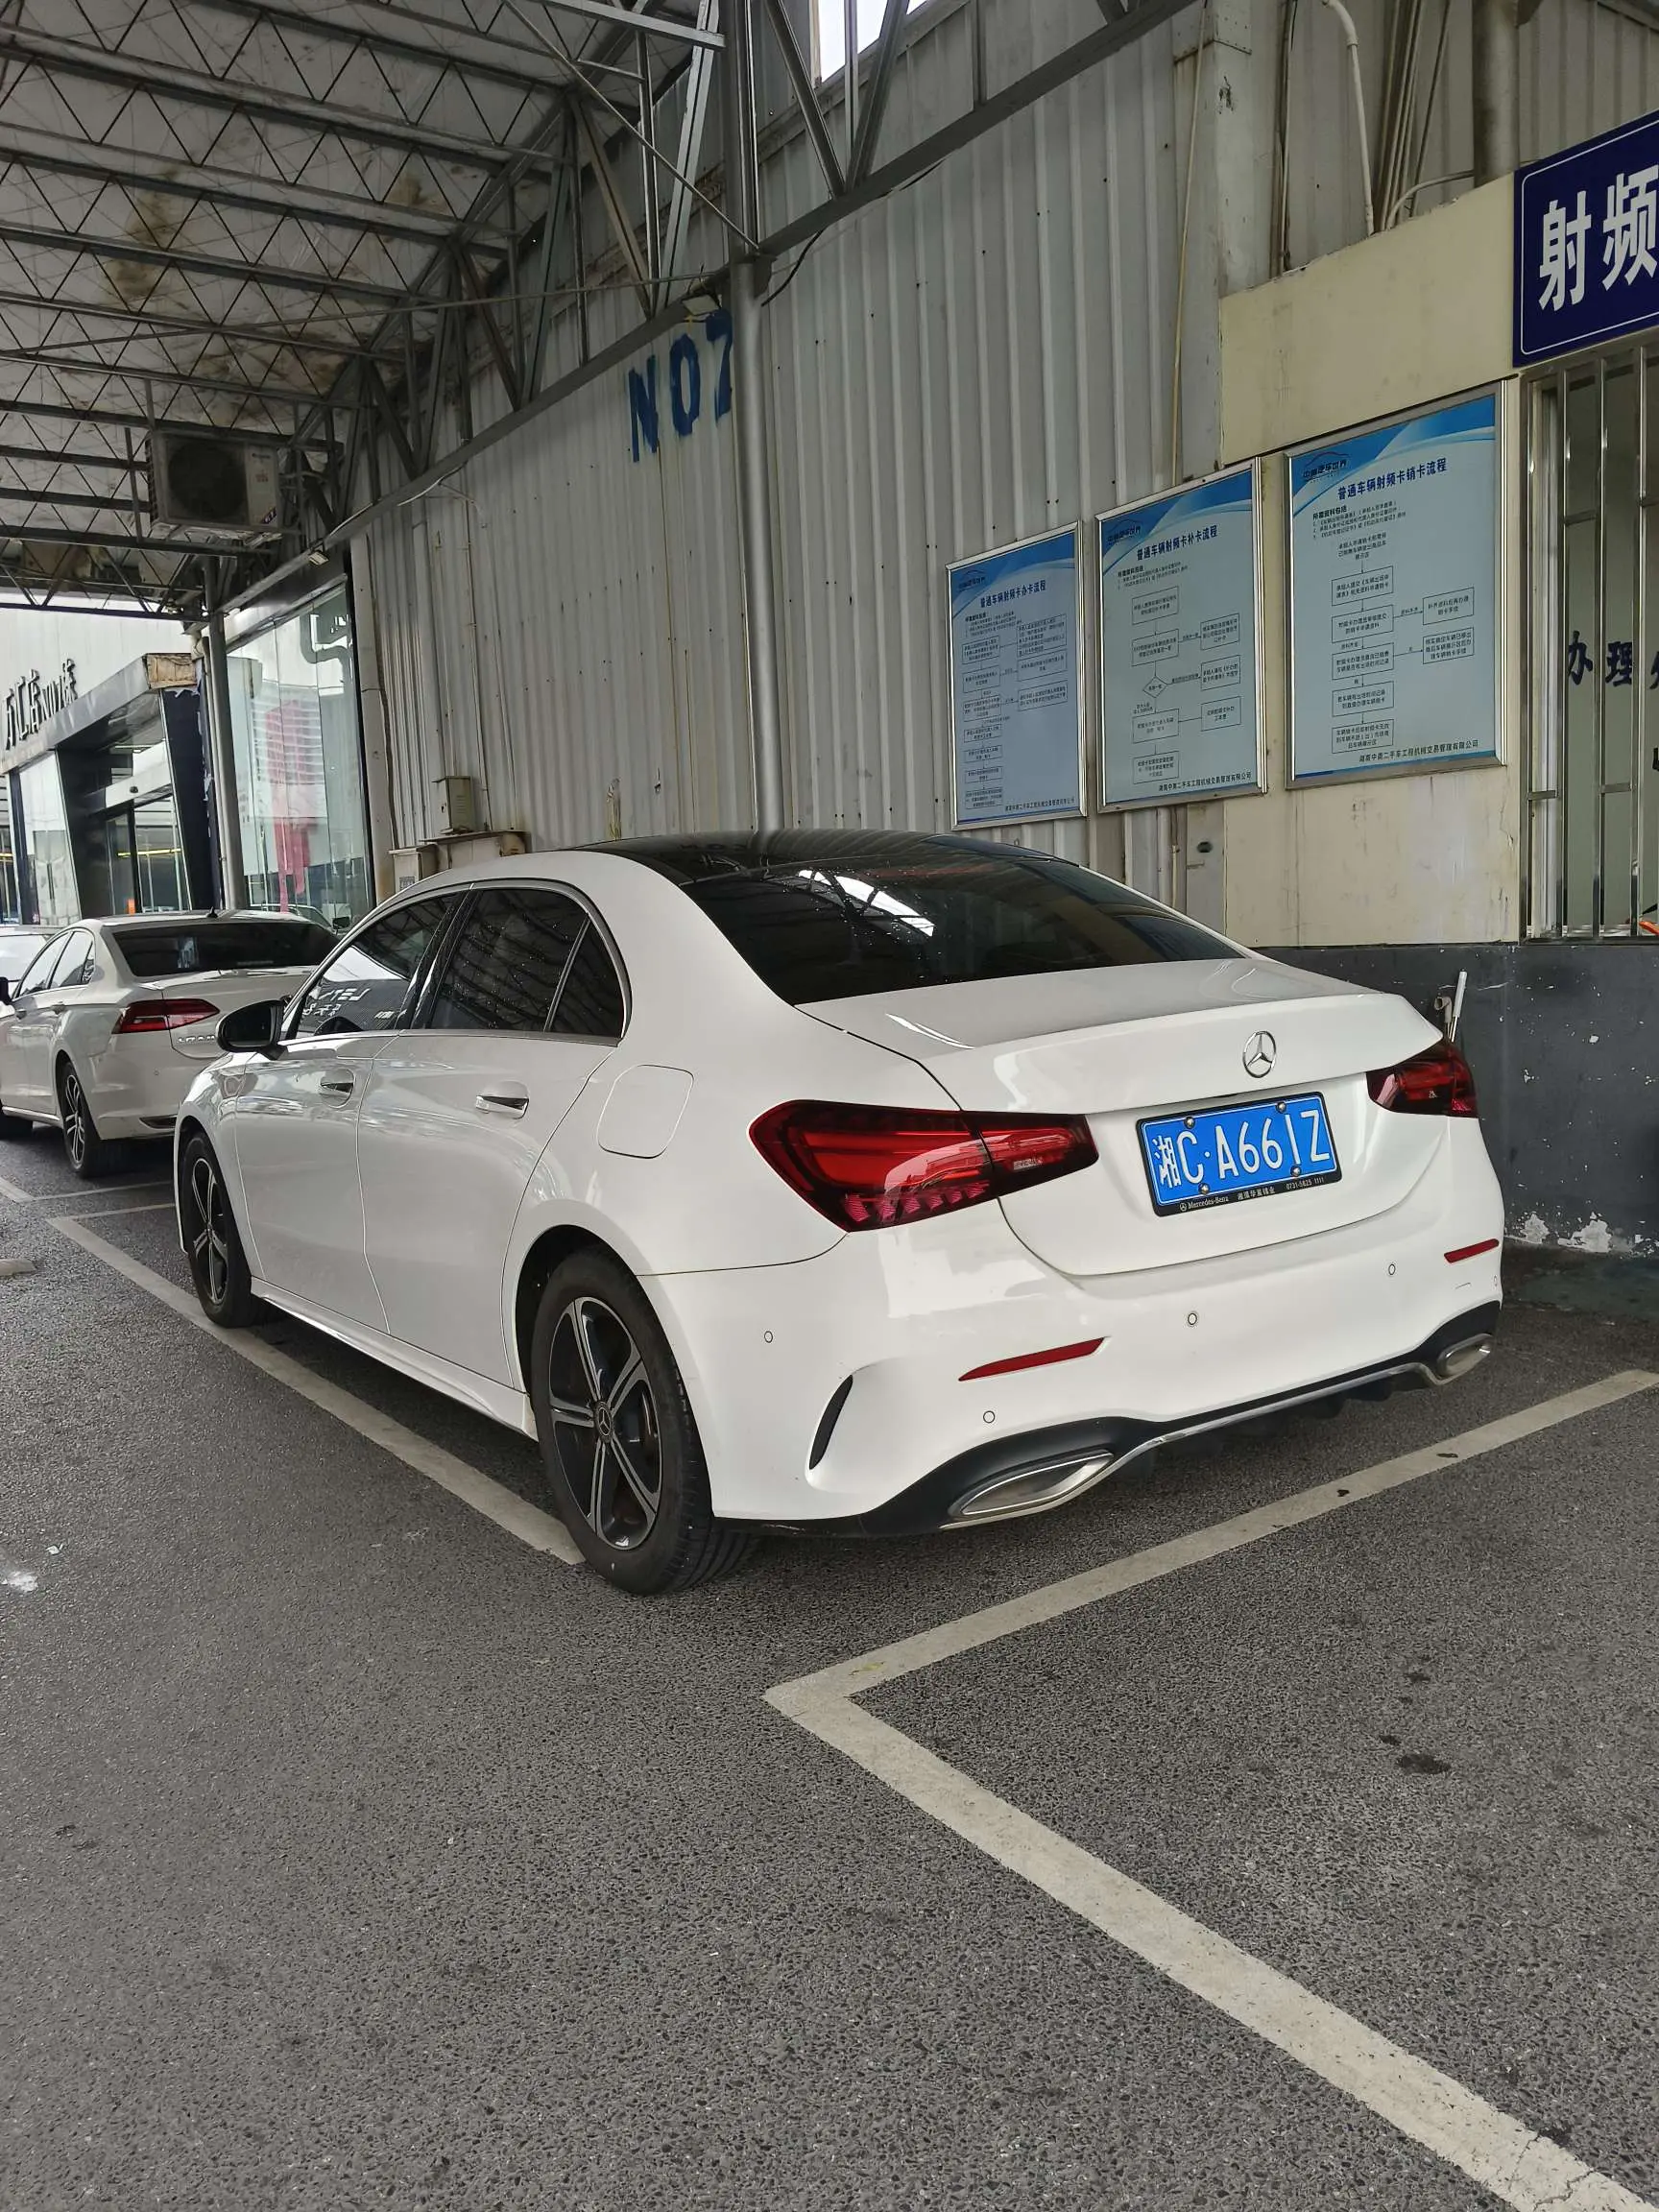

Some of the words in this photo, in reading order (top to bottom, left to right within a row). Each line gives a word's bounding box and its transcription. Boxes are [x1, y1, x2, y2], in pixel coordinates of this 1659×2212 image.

[1538, 164, 1659, 312] 射频
[1337, 458, 1447, 500] 普通车辆射频卡销卡流程
[1137, 525, 1218, 561] 普通车辆射频卡补卡流程
[1188, 1195, 1229, 1210] Mercedes-Benz
